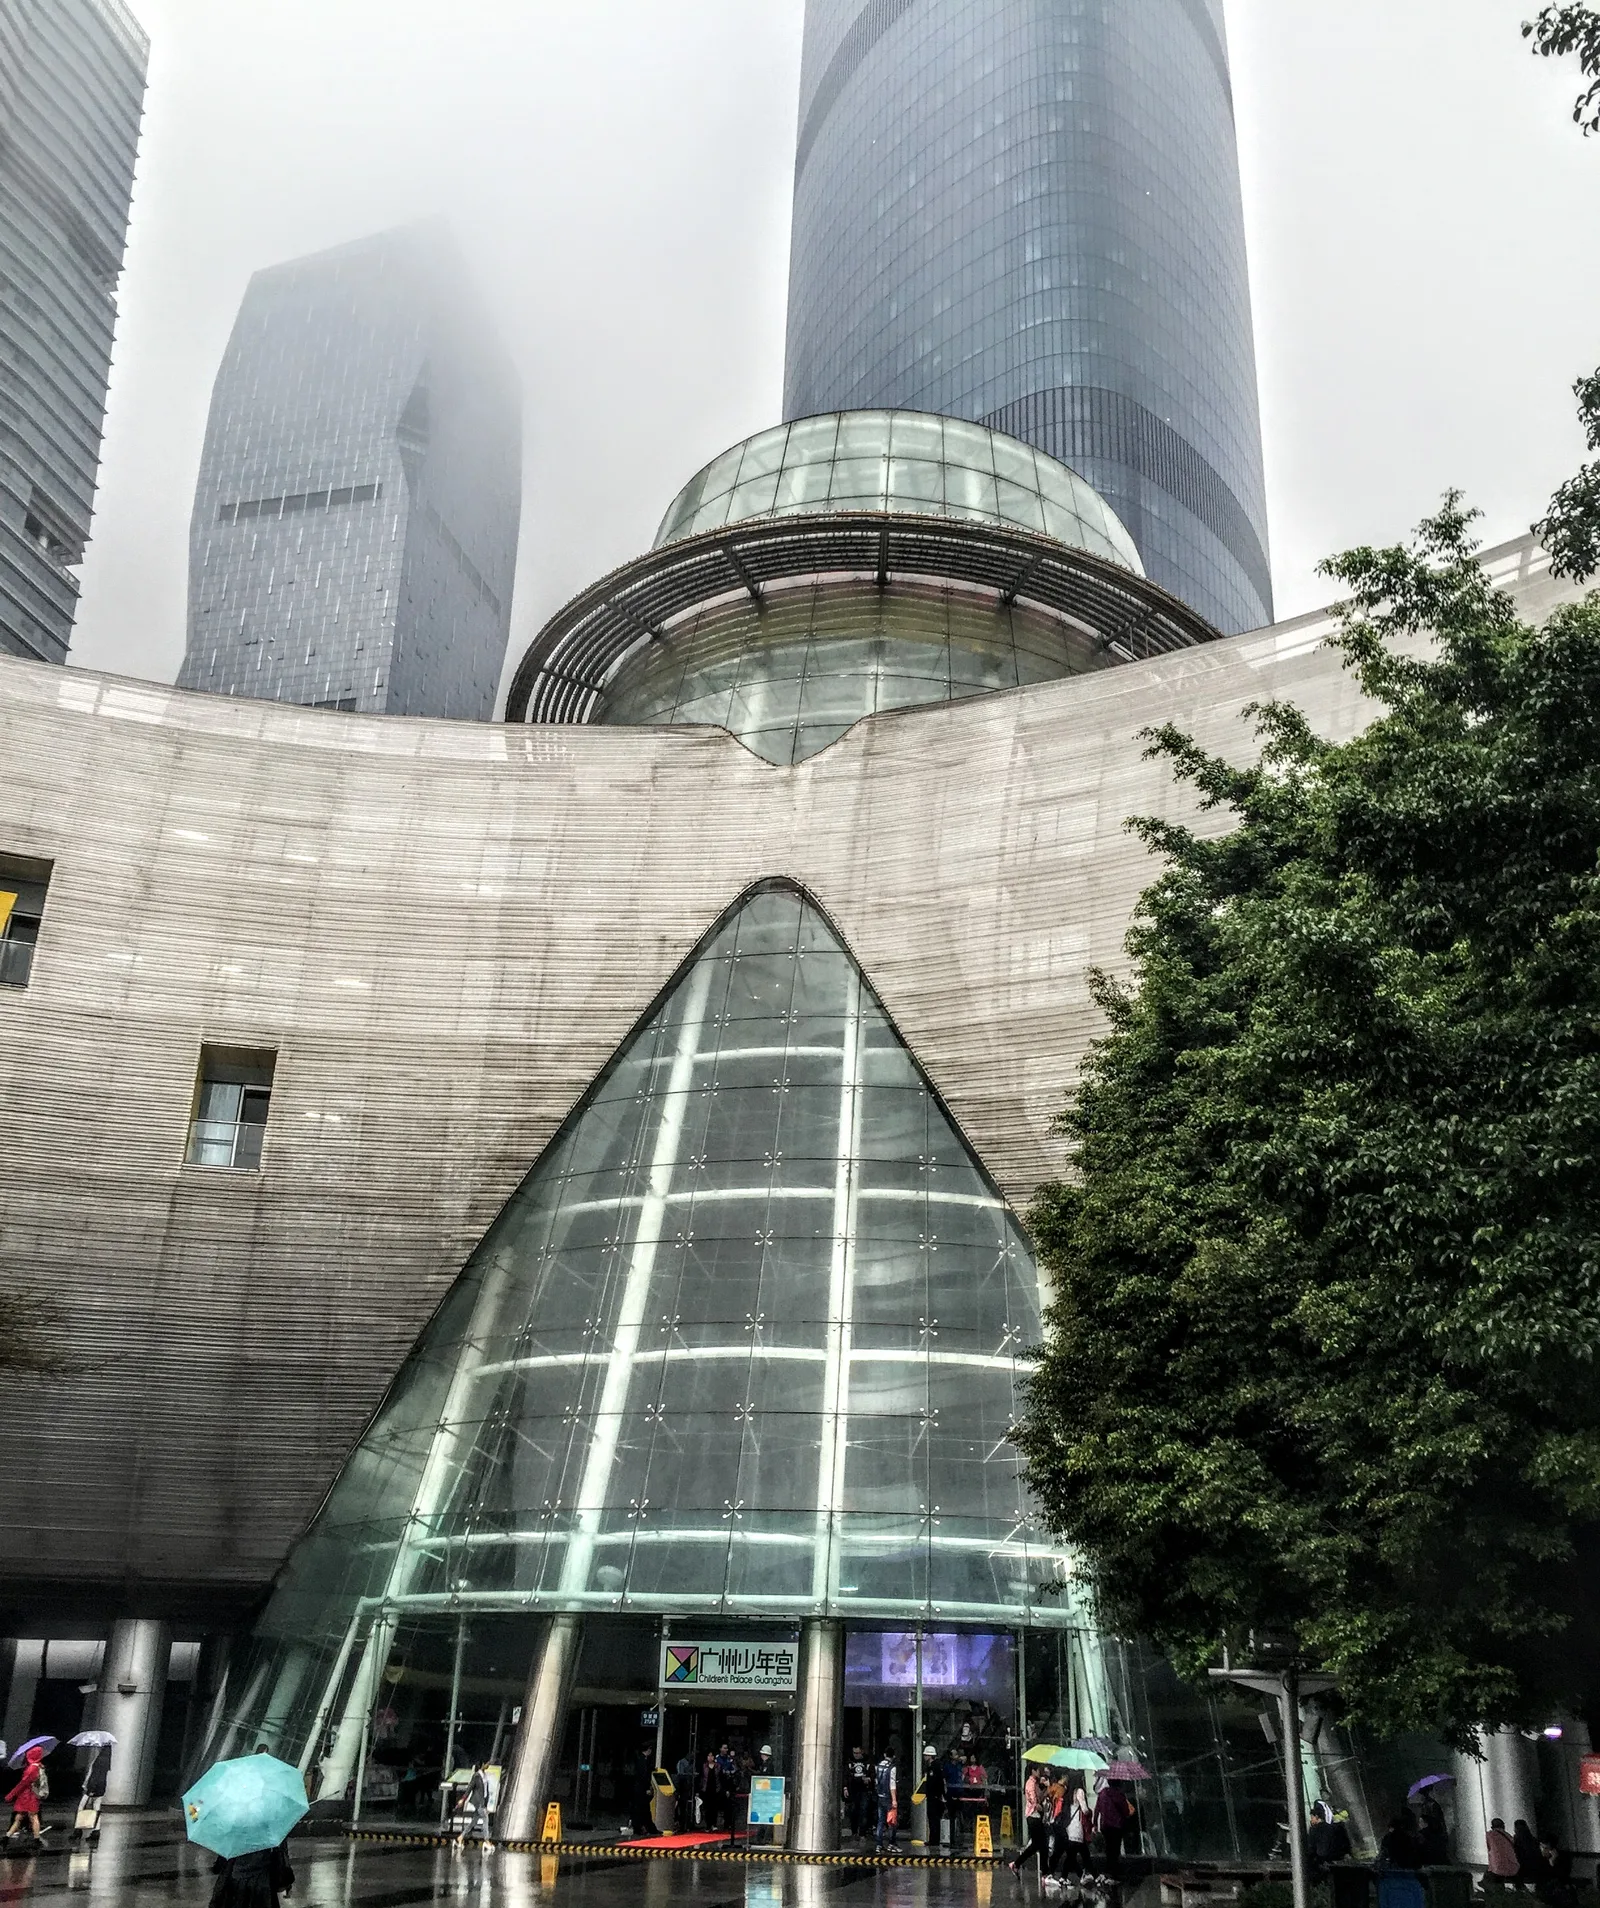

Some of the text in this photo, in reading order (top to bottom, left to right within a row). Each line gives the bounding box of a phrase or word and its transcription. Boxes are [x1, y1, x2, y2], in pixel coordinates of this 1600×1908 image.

[700, 1648, 793, 1675] 广州少年宫
[730, 1675, 753, 1684] Palace
[754, 1675, 793, 1686] Guangzhou
